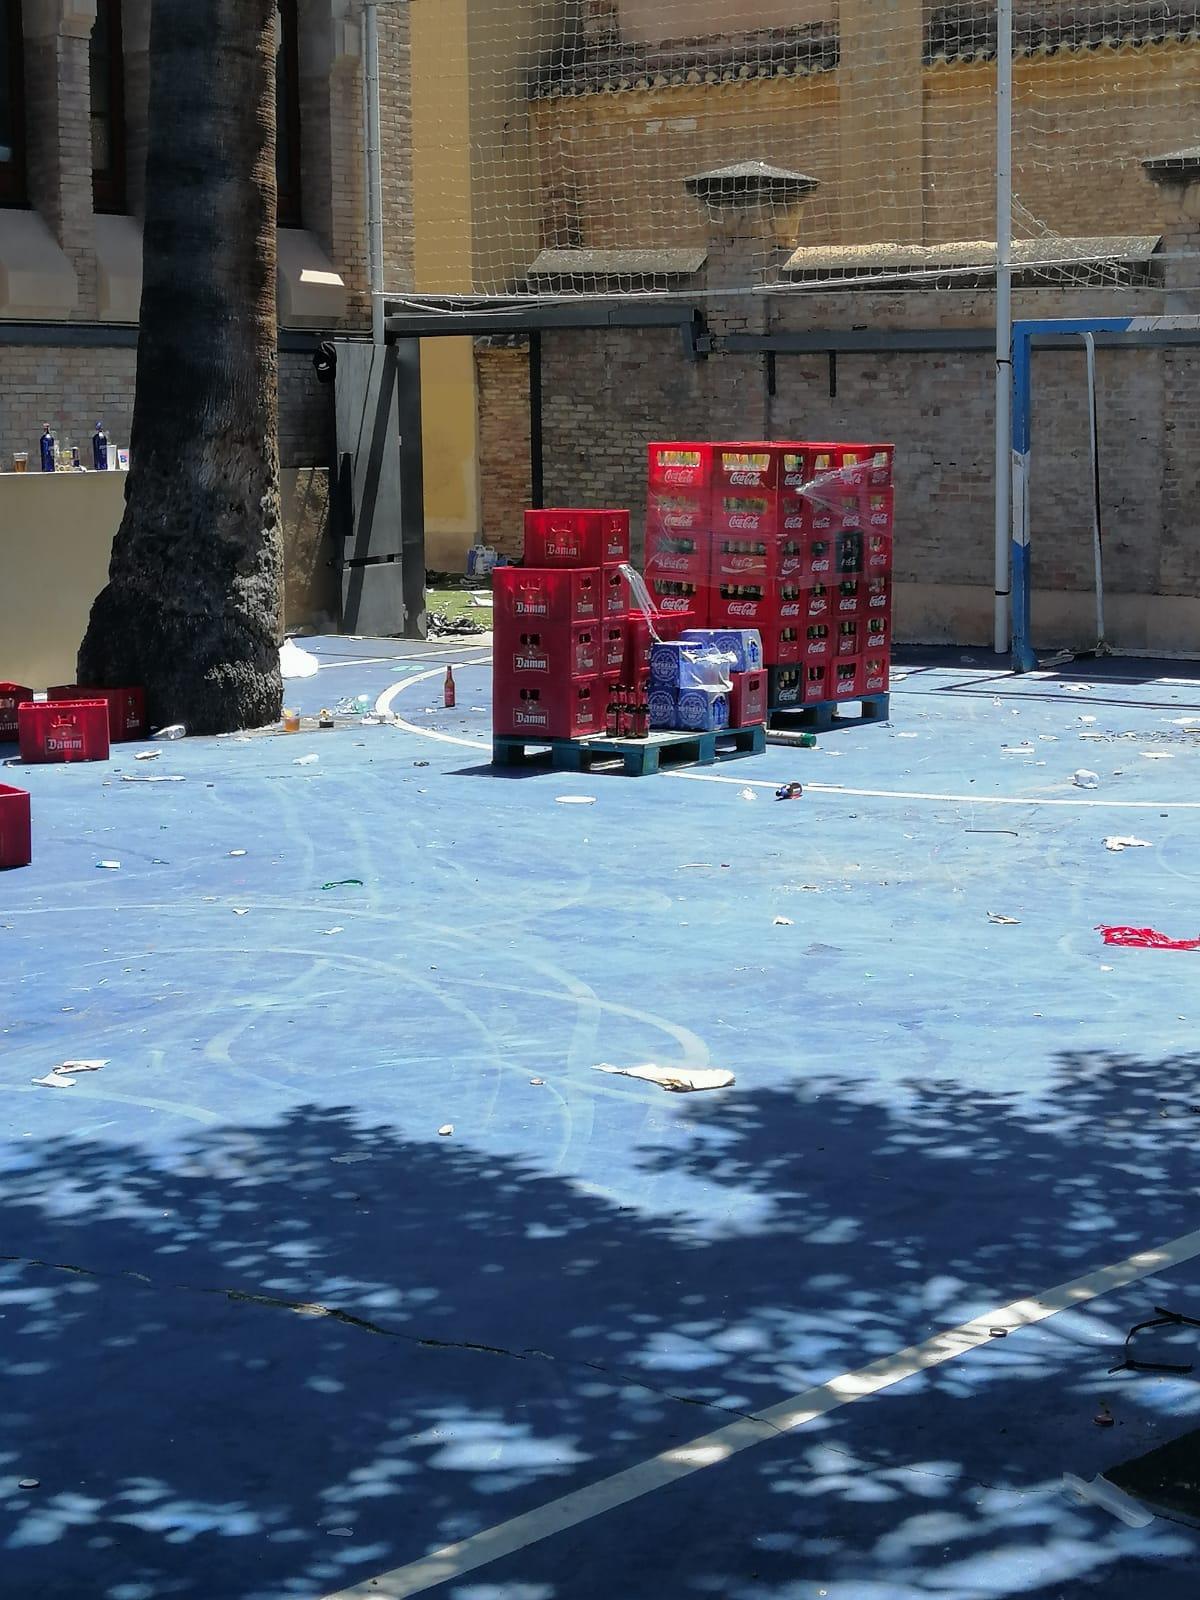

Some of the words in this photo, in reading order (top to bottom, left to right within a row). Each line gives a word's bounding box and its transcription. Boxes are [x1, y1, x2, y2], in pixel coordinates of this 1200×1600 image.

[730, 471, 760, 485] Coca-Cola
[729, 515, 759, 529] Coca-Cola
[547, 543, 577, 556] Damm
[516, 602, 546, 614] Damm
[661, 597, 690, 611] Coca-Cola
[728, 602, 757, 616] Coca-Cola
[516, 657, 546, 669] Damm
[516, 712, 546, 724] Damm
[0, 721, 19, 731] amm
[48, 739, 82, 750] Damm
